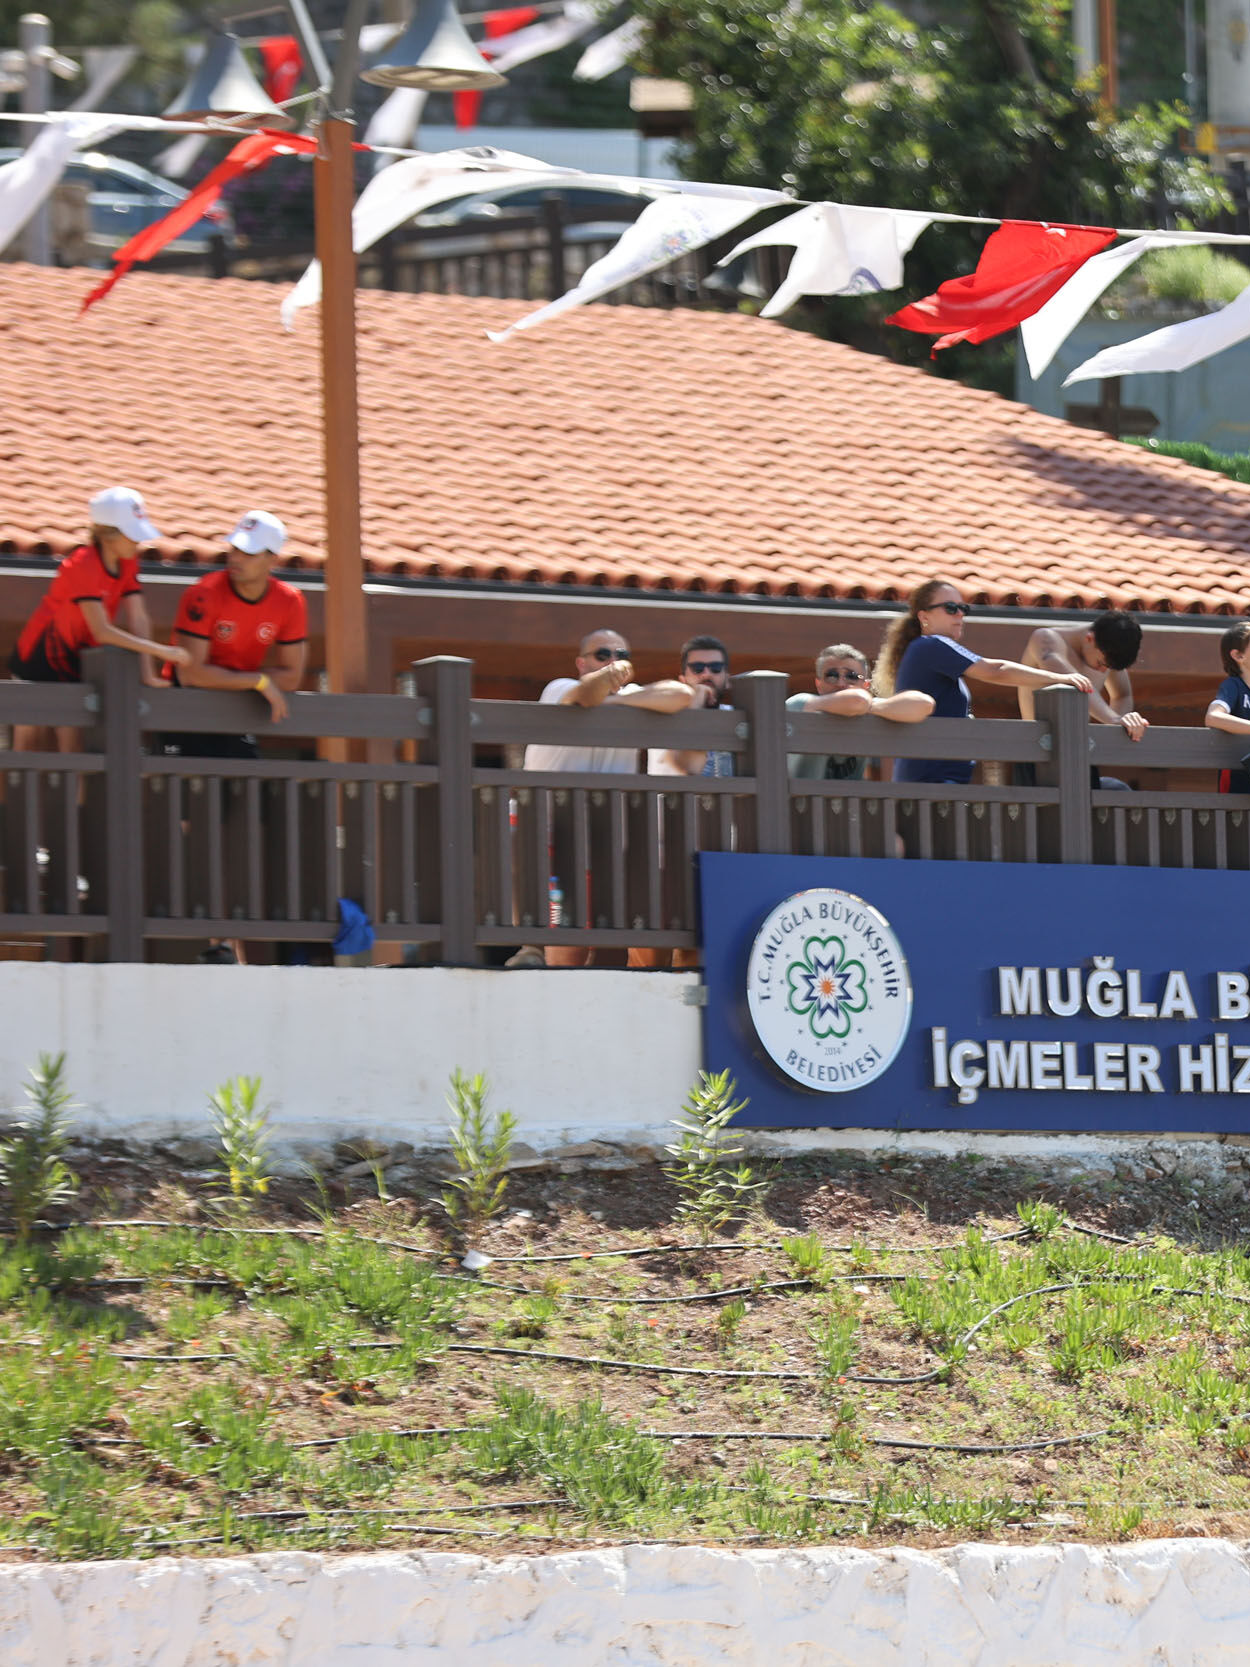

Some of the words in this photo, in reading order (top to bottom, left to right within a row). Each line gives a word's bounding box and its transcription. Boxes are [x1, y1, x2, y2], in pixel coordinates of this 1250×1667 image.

[819, 900, 899, 999] BÜYÜKŞEHİR
[998, 955, 1199, 1020] MUĞLA
[785, 1043, 883, 1083] BELEDİYESİ
[931, 1026, 1166, 1106] İÇMELER
